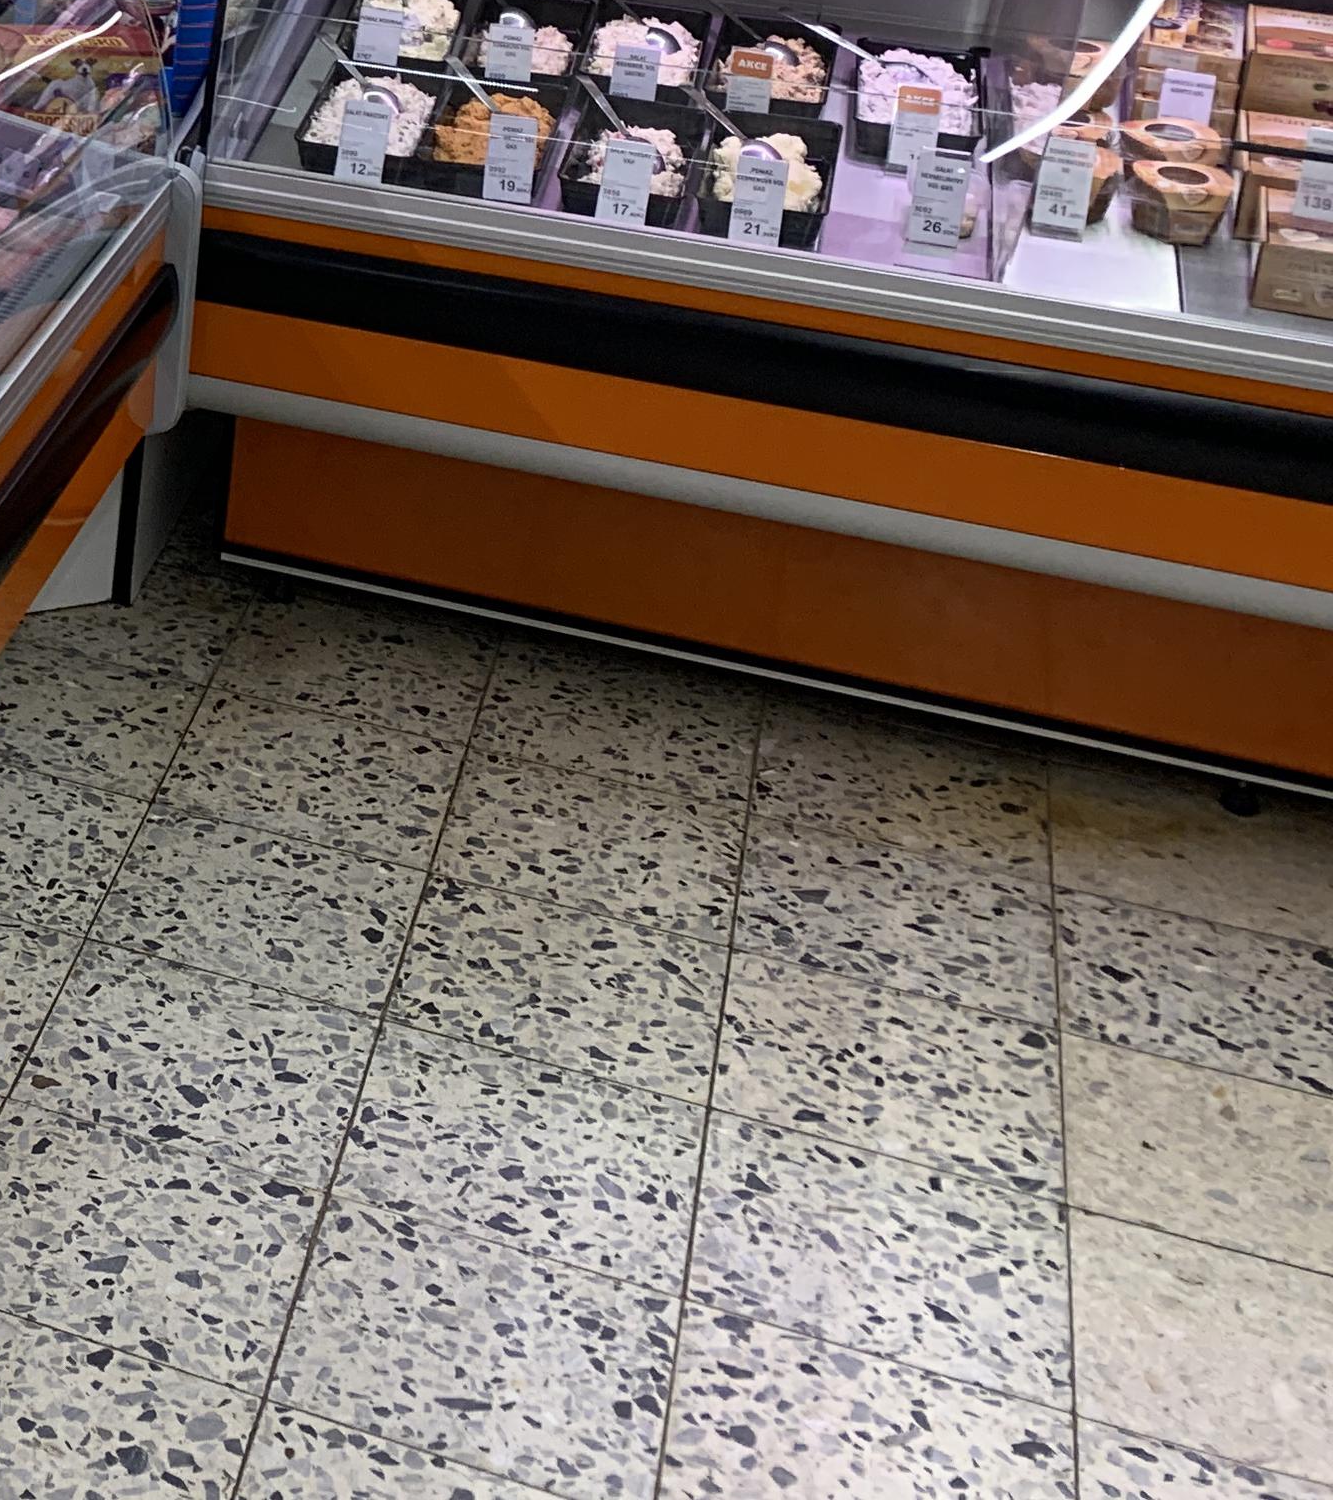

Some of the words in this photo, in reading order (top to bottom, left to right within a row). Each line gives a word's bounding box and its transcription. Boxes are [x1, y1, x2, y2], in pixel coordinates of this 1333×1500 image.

[737, 58, 768, 72] AKCE
[350, 162, 367, 176] 12
[499, 178, 516, 192] 19
[612, 202, 629, 216] 17
[1302, 193, 1331, 212] 139
[1048, 203, 1067, 217] 41
[743, 221, 761, 236] 21
[922, 219, 942, 234] 26
